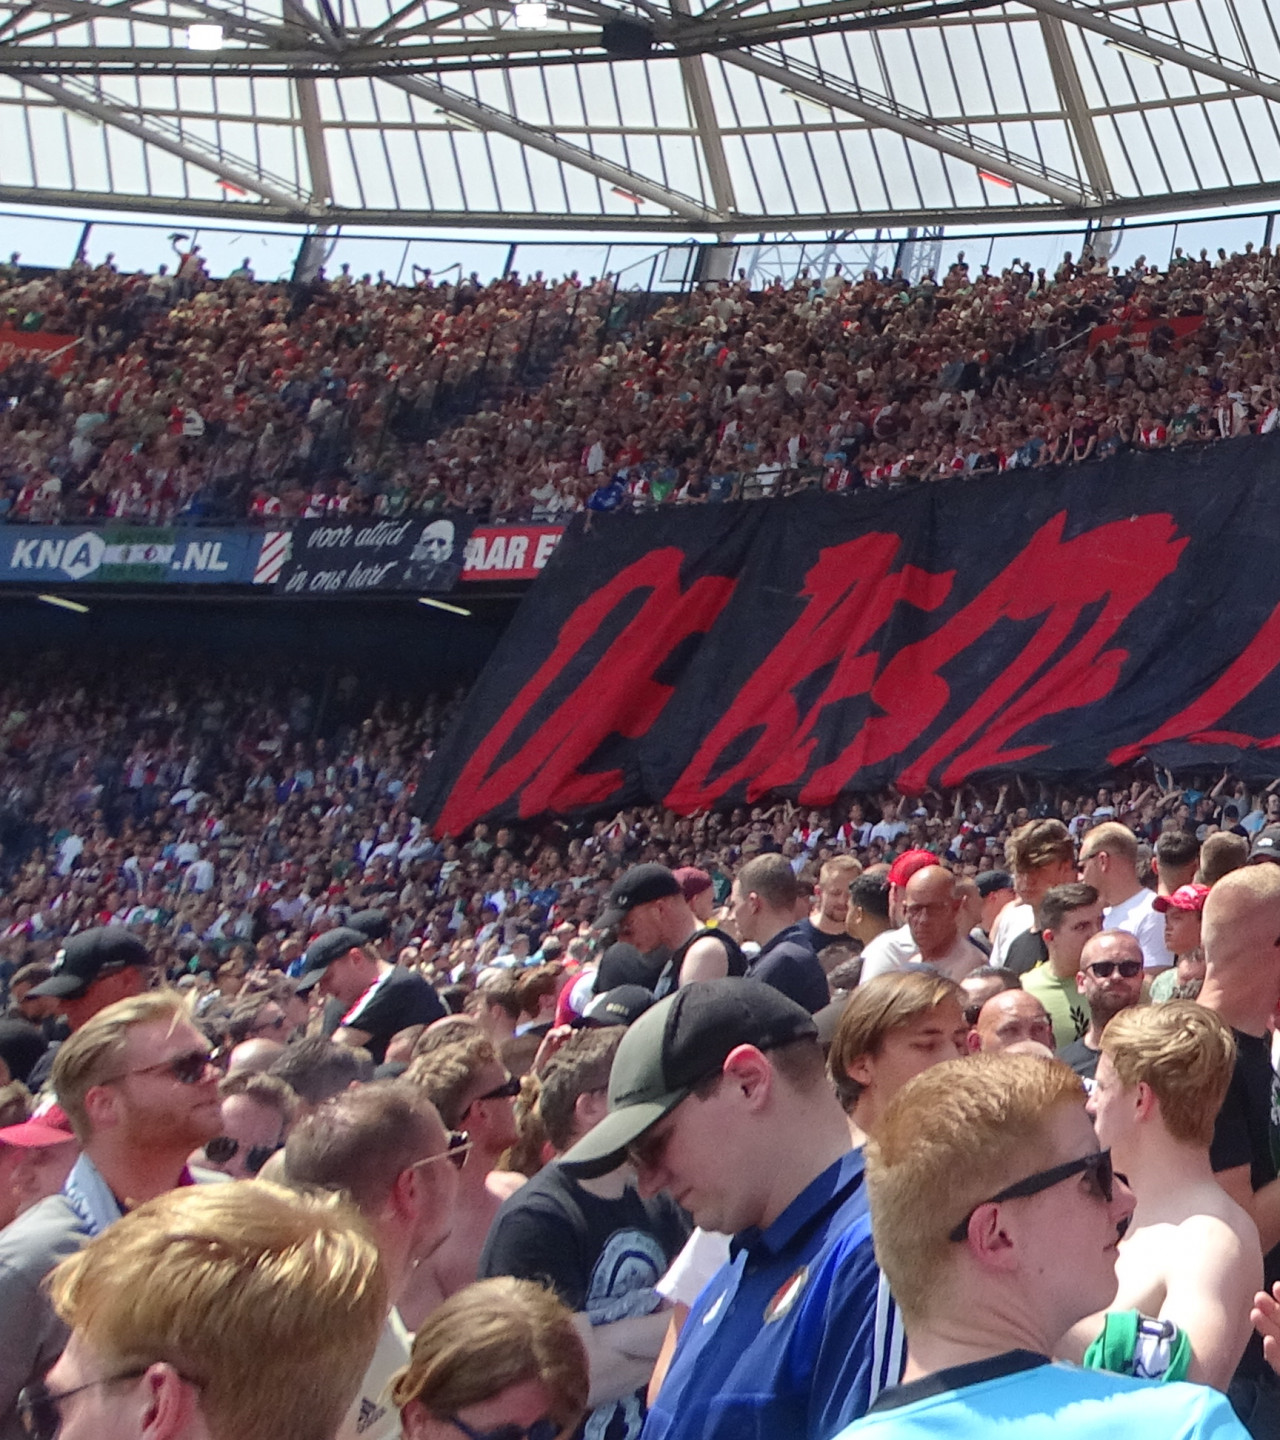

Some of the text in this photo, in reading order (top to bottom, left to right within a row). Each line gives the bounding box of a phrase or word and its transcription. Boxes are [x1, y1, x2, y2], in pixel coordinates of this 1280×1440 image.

[307, 525, 353, 548] voor
[533, 534, 560, 569] E
[285, 560, 398, 591] in ons hart
[432, 546, 738, 840] DE
[662, 509, 1191, 817] BESTE
